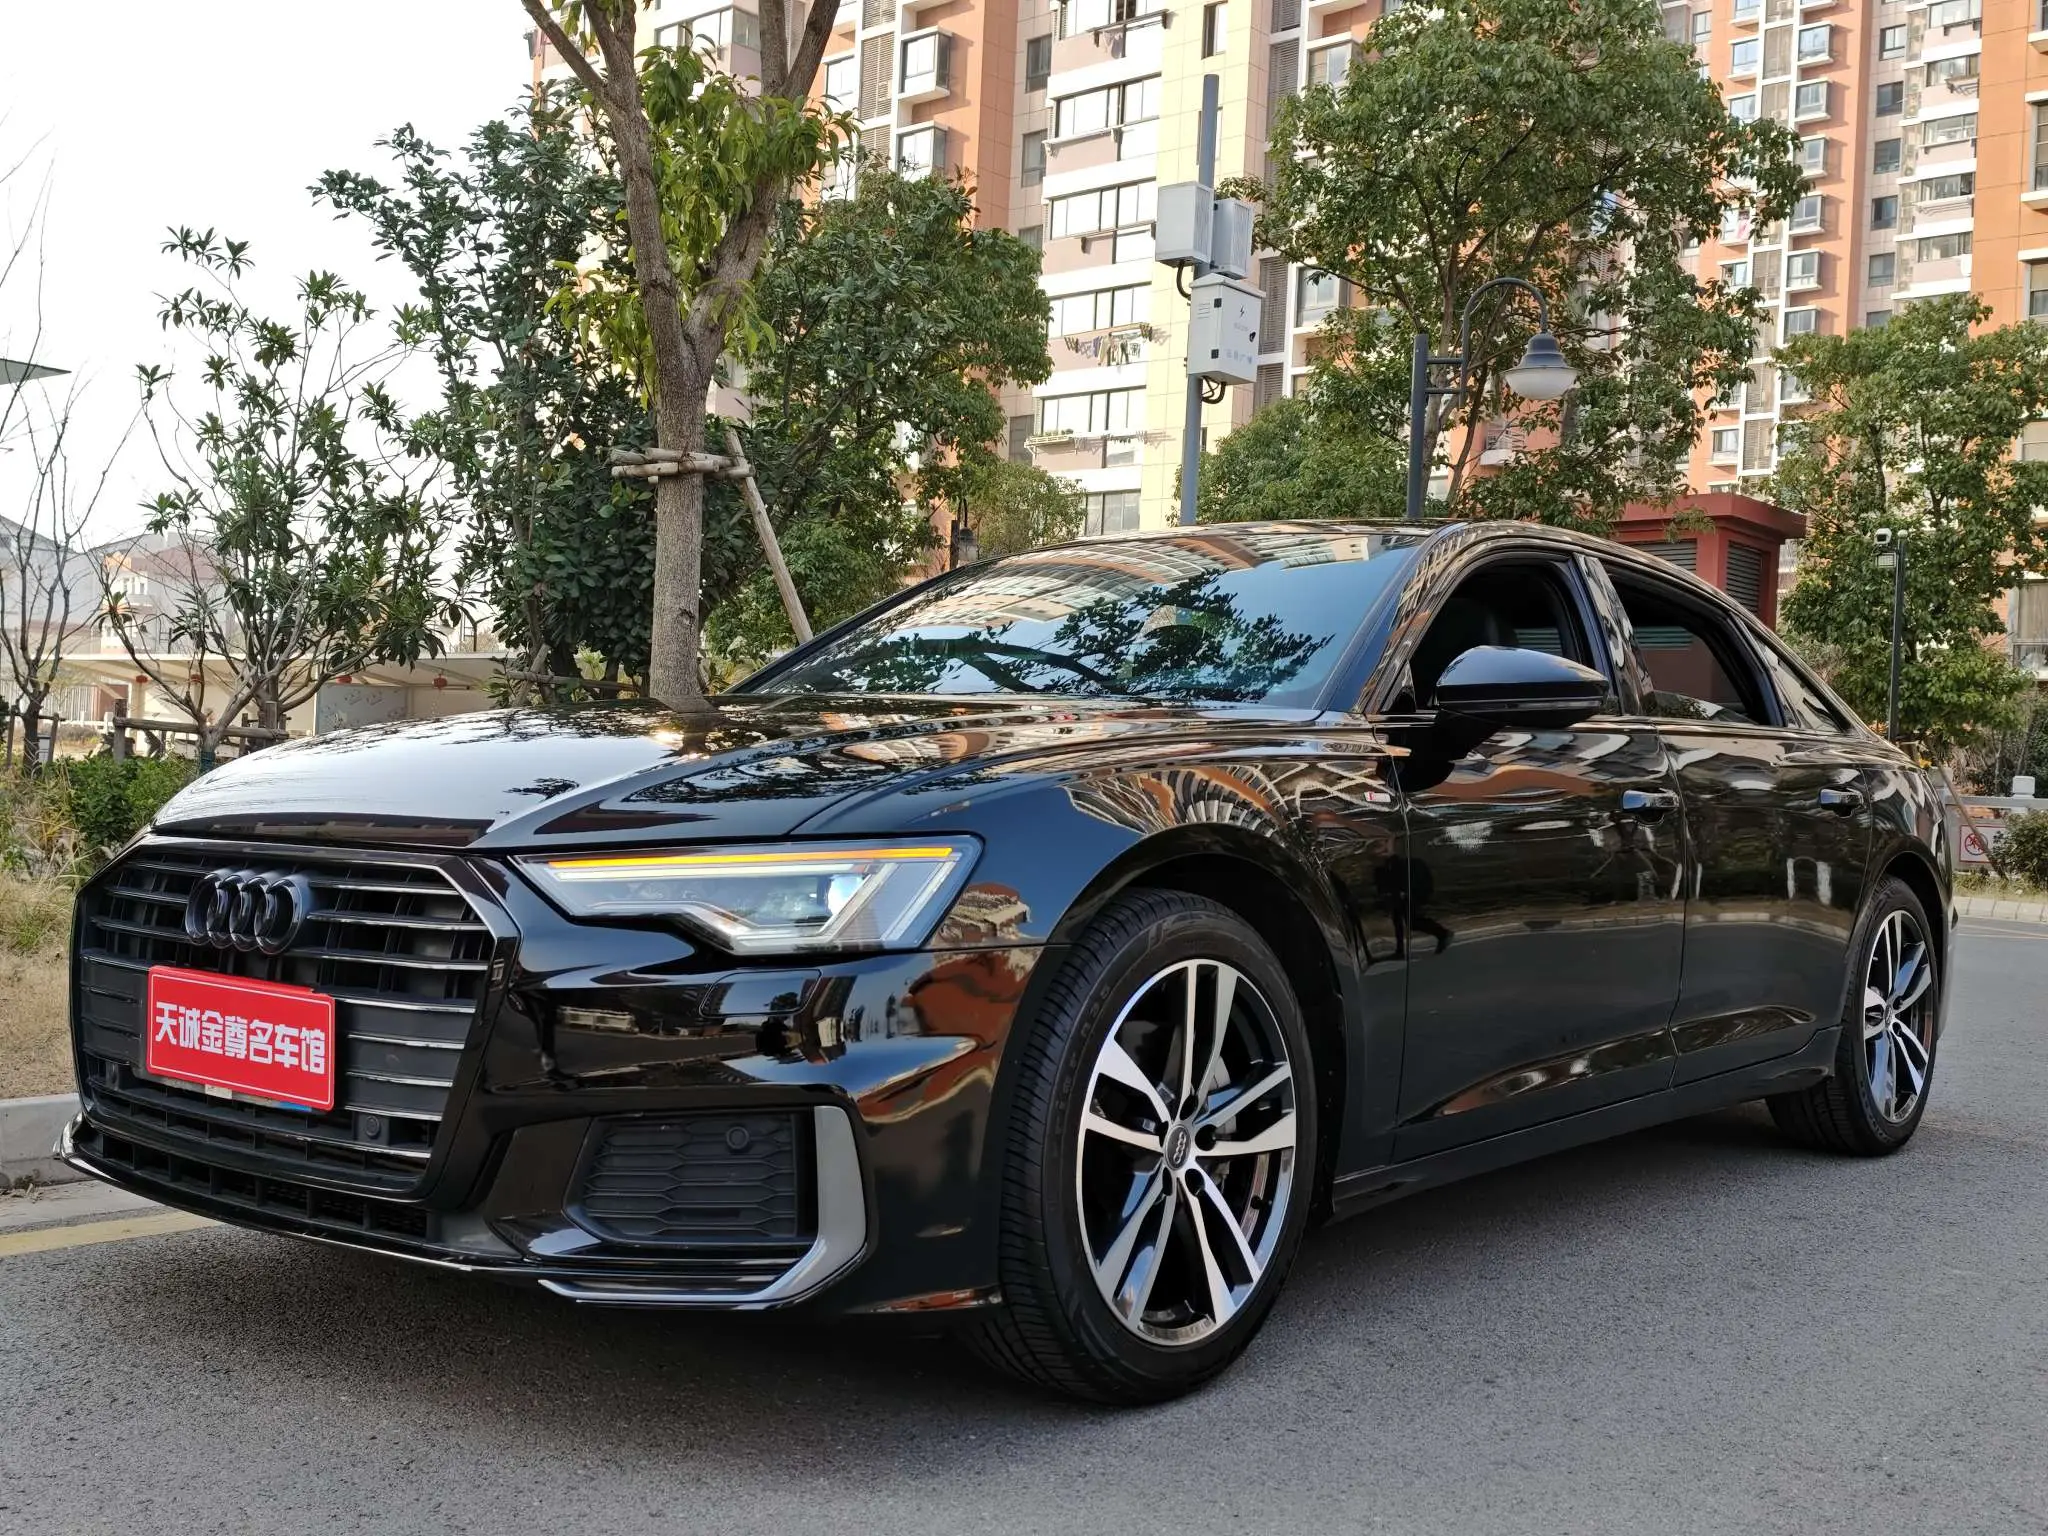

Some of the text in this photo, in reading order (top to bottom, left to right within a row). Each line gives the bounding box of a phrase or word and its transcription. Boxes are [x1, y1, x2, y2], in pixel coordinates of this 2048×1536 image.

[155, 1001, 325, 1075] 天诚金尊名车馆
